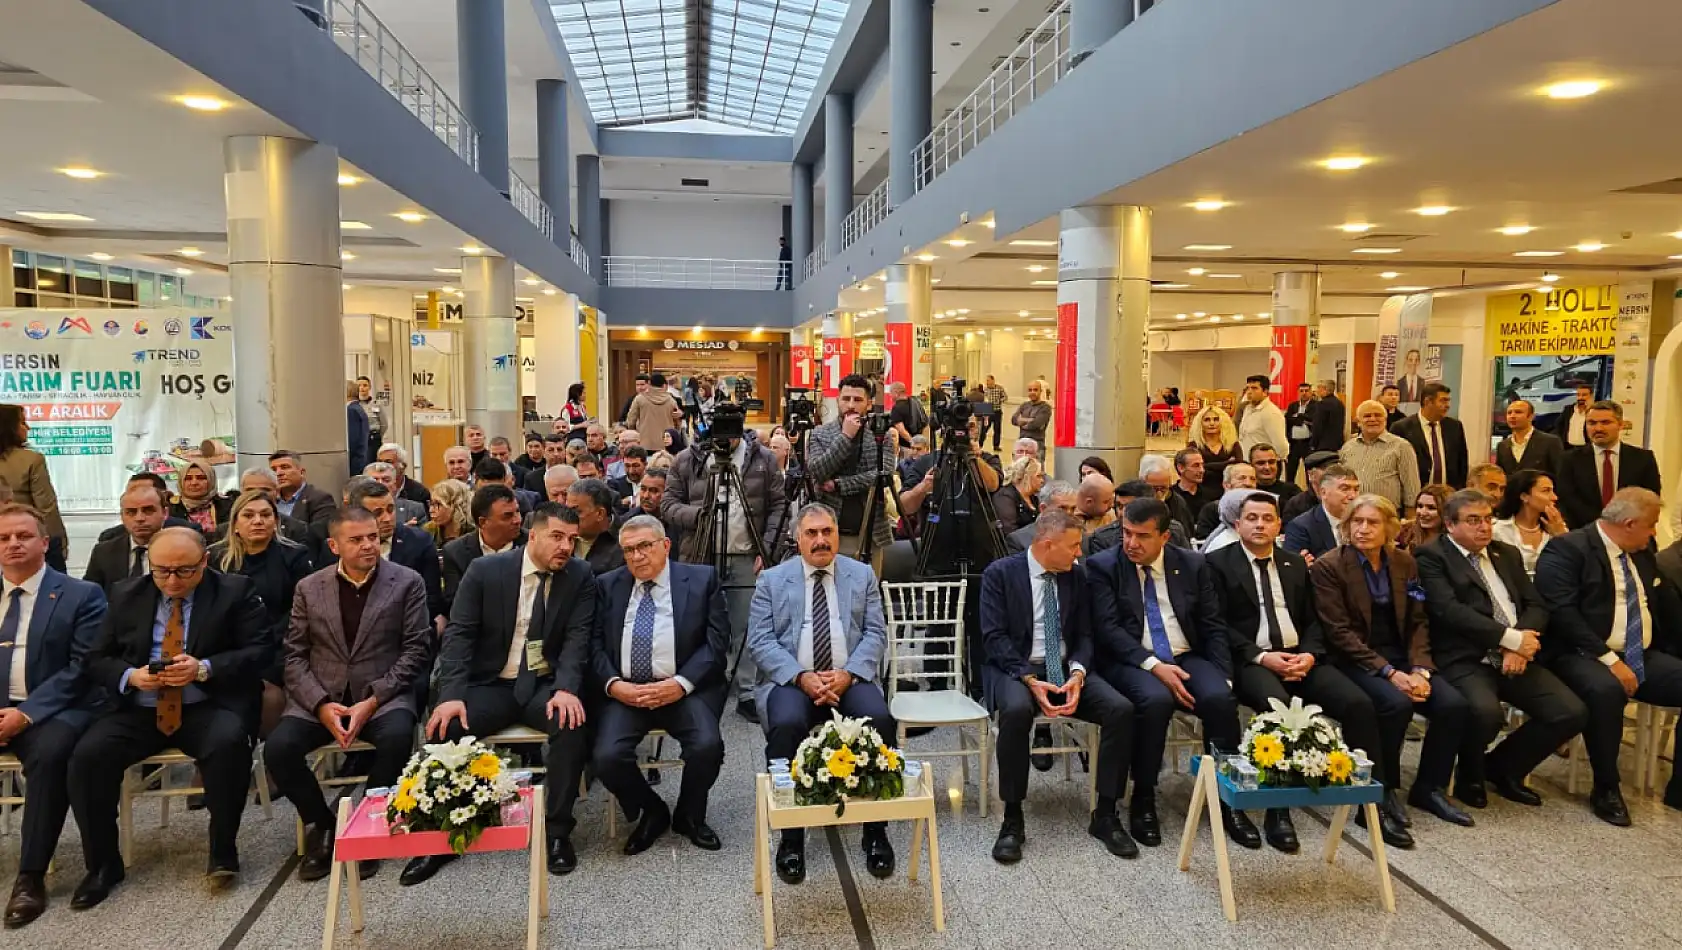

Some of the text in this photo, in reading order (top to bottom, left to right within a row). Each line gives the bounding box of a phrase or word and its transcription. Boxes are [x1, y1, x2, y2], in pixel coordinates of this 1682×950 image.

[1519, 293, 1536, 316] 2.
[1501, 318, 1548, 336] MAKİNE
[147, 349, 200, 360] TREND
[1501, 338, 1536, 352] TARIM
[0, 353, 60, 369] ERSİN
[0, 370, 141, 392] ARIM FUARI
[796, 358, 810, 385] 1
[824, 355, 840, 389] 1
[161, 374, 234, 400] HOŞ G
[49, 405, 109, 418] ARALIK
